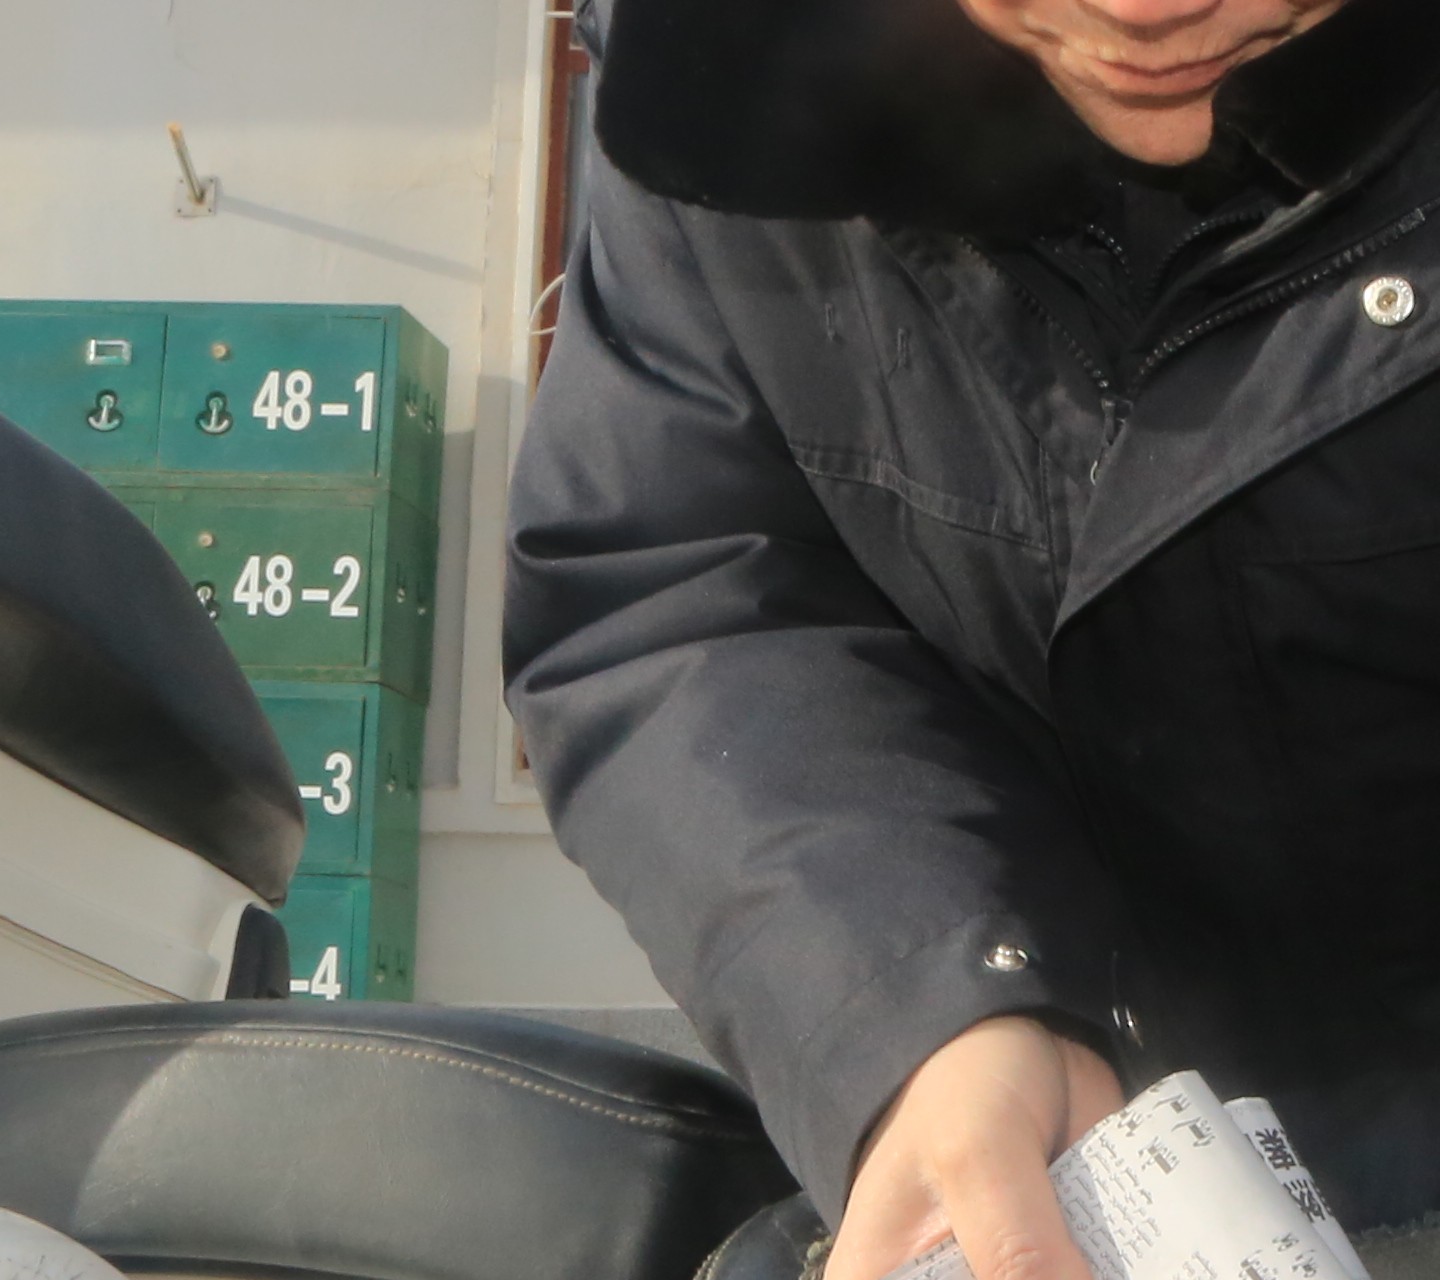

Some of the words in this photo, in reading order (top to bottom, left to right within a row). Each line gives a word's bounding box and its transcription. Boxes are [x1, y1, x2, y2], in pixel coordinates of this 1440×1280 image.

[252, 368, 377, 433] 48-1
[233, 554, 361, 619] 48-2
[298, 751, 353, 816] -3
[290, 944, 342, 1000] -4
